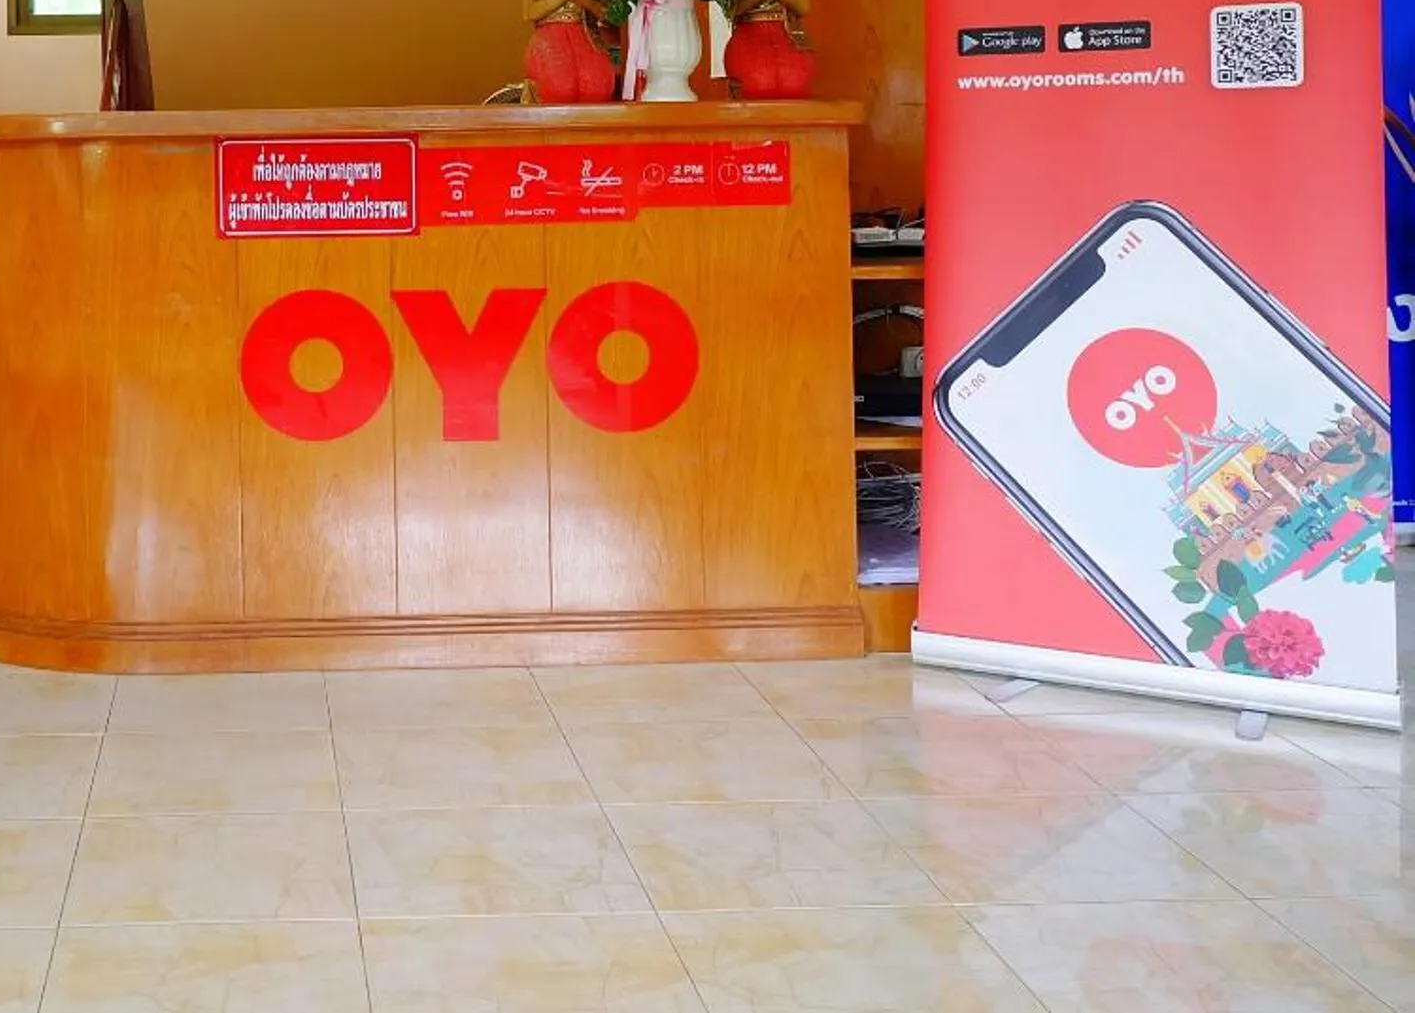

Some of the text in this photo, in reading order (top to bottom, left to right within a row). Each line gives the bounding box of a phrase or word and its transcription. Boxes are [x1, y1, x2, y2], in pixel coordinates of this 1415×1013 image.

[982, 36, 1019, 49] Google
[1088, 34, 1142, 48] App Store
[957, 67, 1185, 91] www.oyorooms.com/th
[673, 164, 704, 175] 2 PM
[741, 163, 777, 174] 12 PM
[240, 281, 700, 441] OYO
[1104, 365, 1176, 431] OYO
